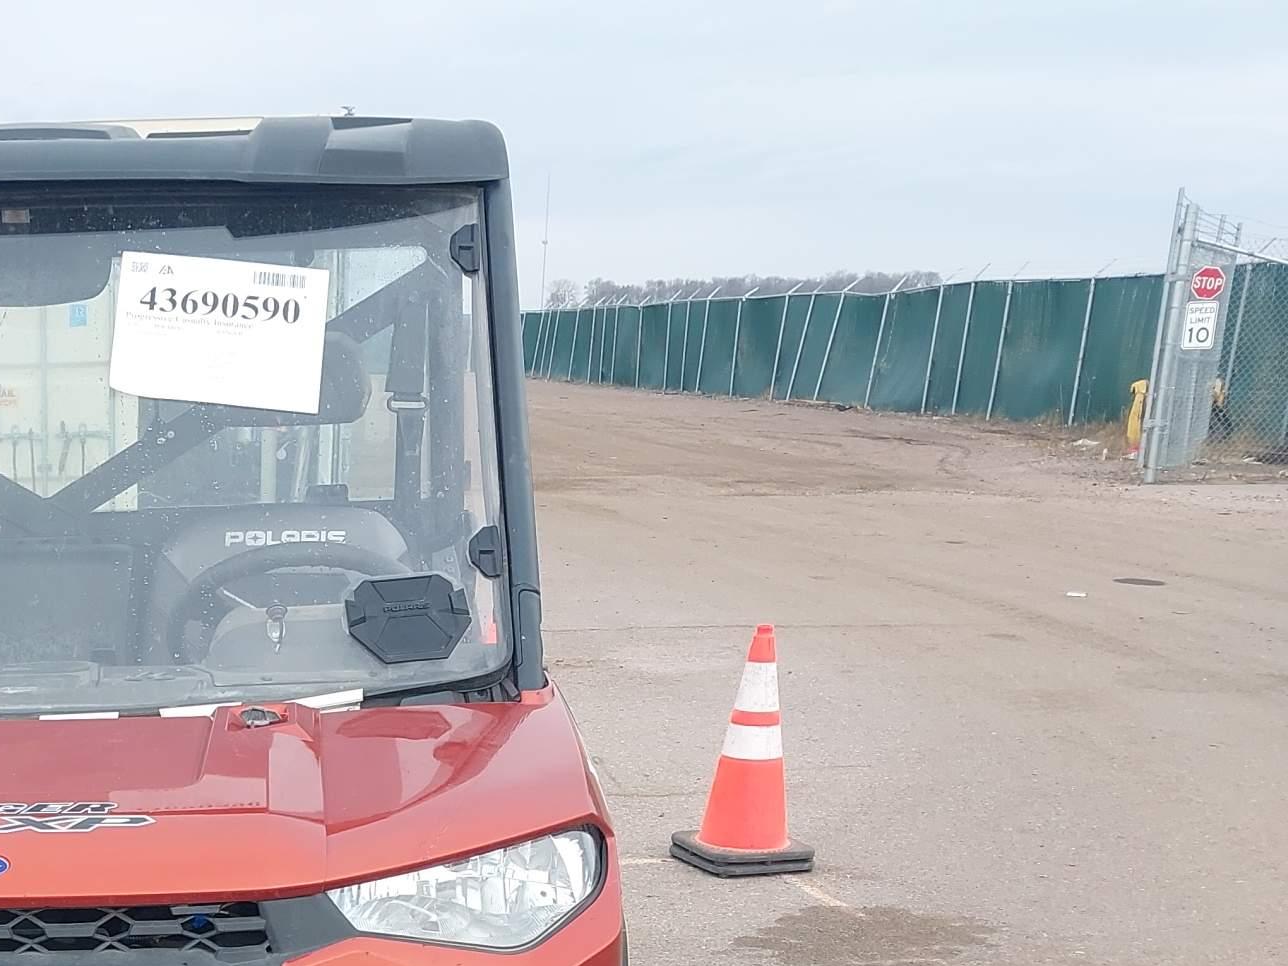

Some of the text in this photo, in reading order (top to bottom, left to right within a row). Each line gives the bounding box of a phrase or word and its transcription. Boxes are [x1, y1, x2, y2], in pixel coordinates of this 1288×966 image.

[1193, 276, 1223, 290] STOP
[139, 286, 300, 324] 43690590
[1190, 306, 1215, 314] SPEED
[1190, 316, 1211, 324] LIMIT
[1188, 326, 1210, 343] 10
[225, 530, 347, 547] POLARIS
[383, 603, 432, 612] POLARIS
